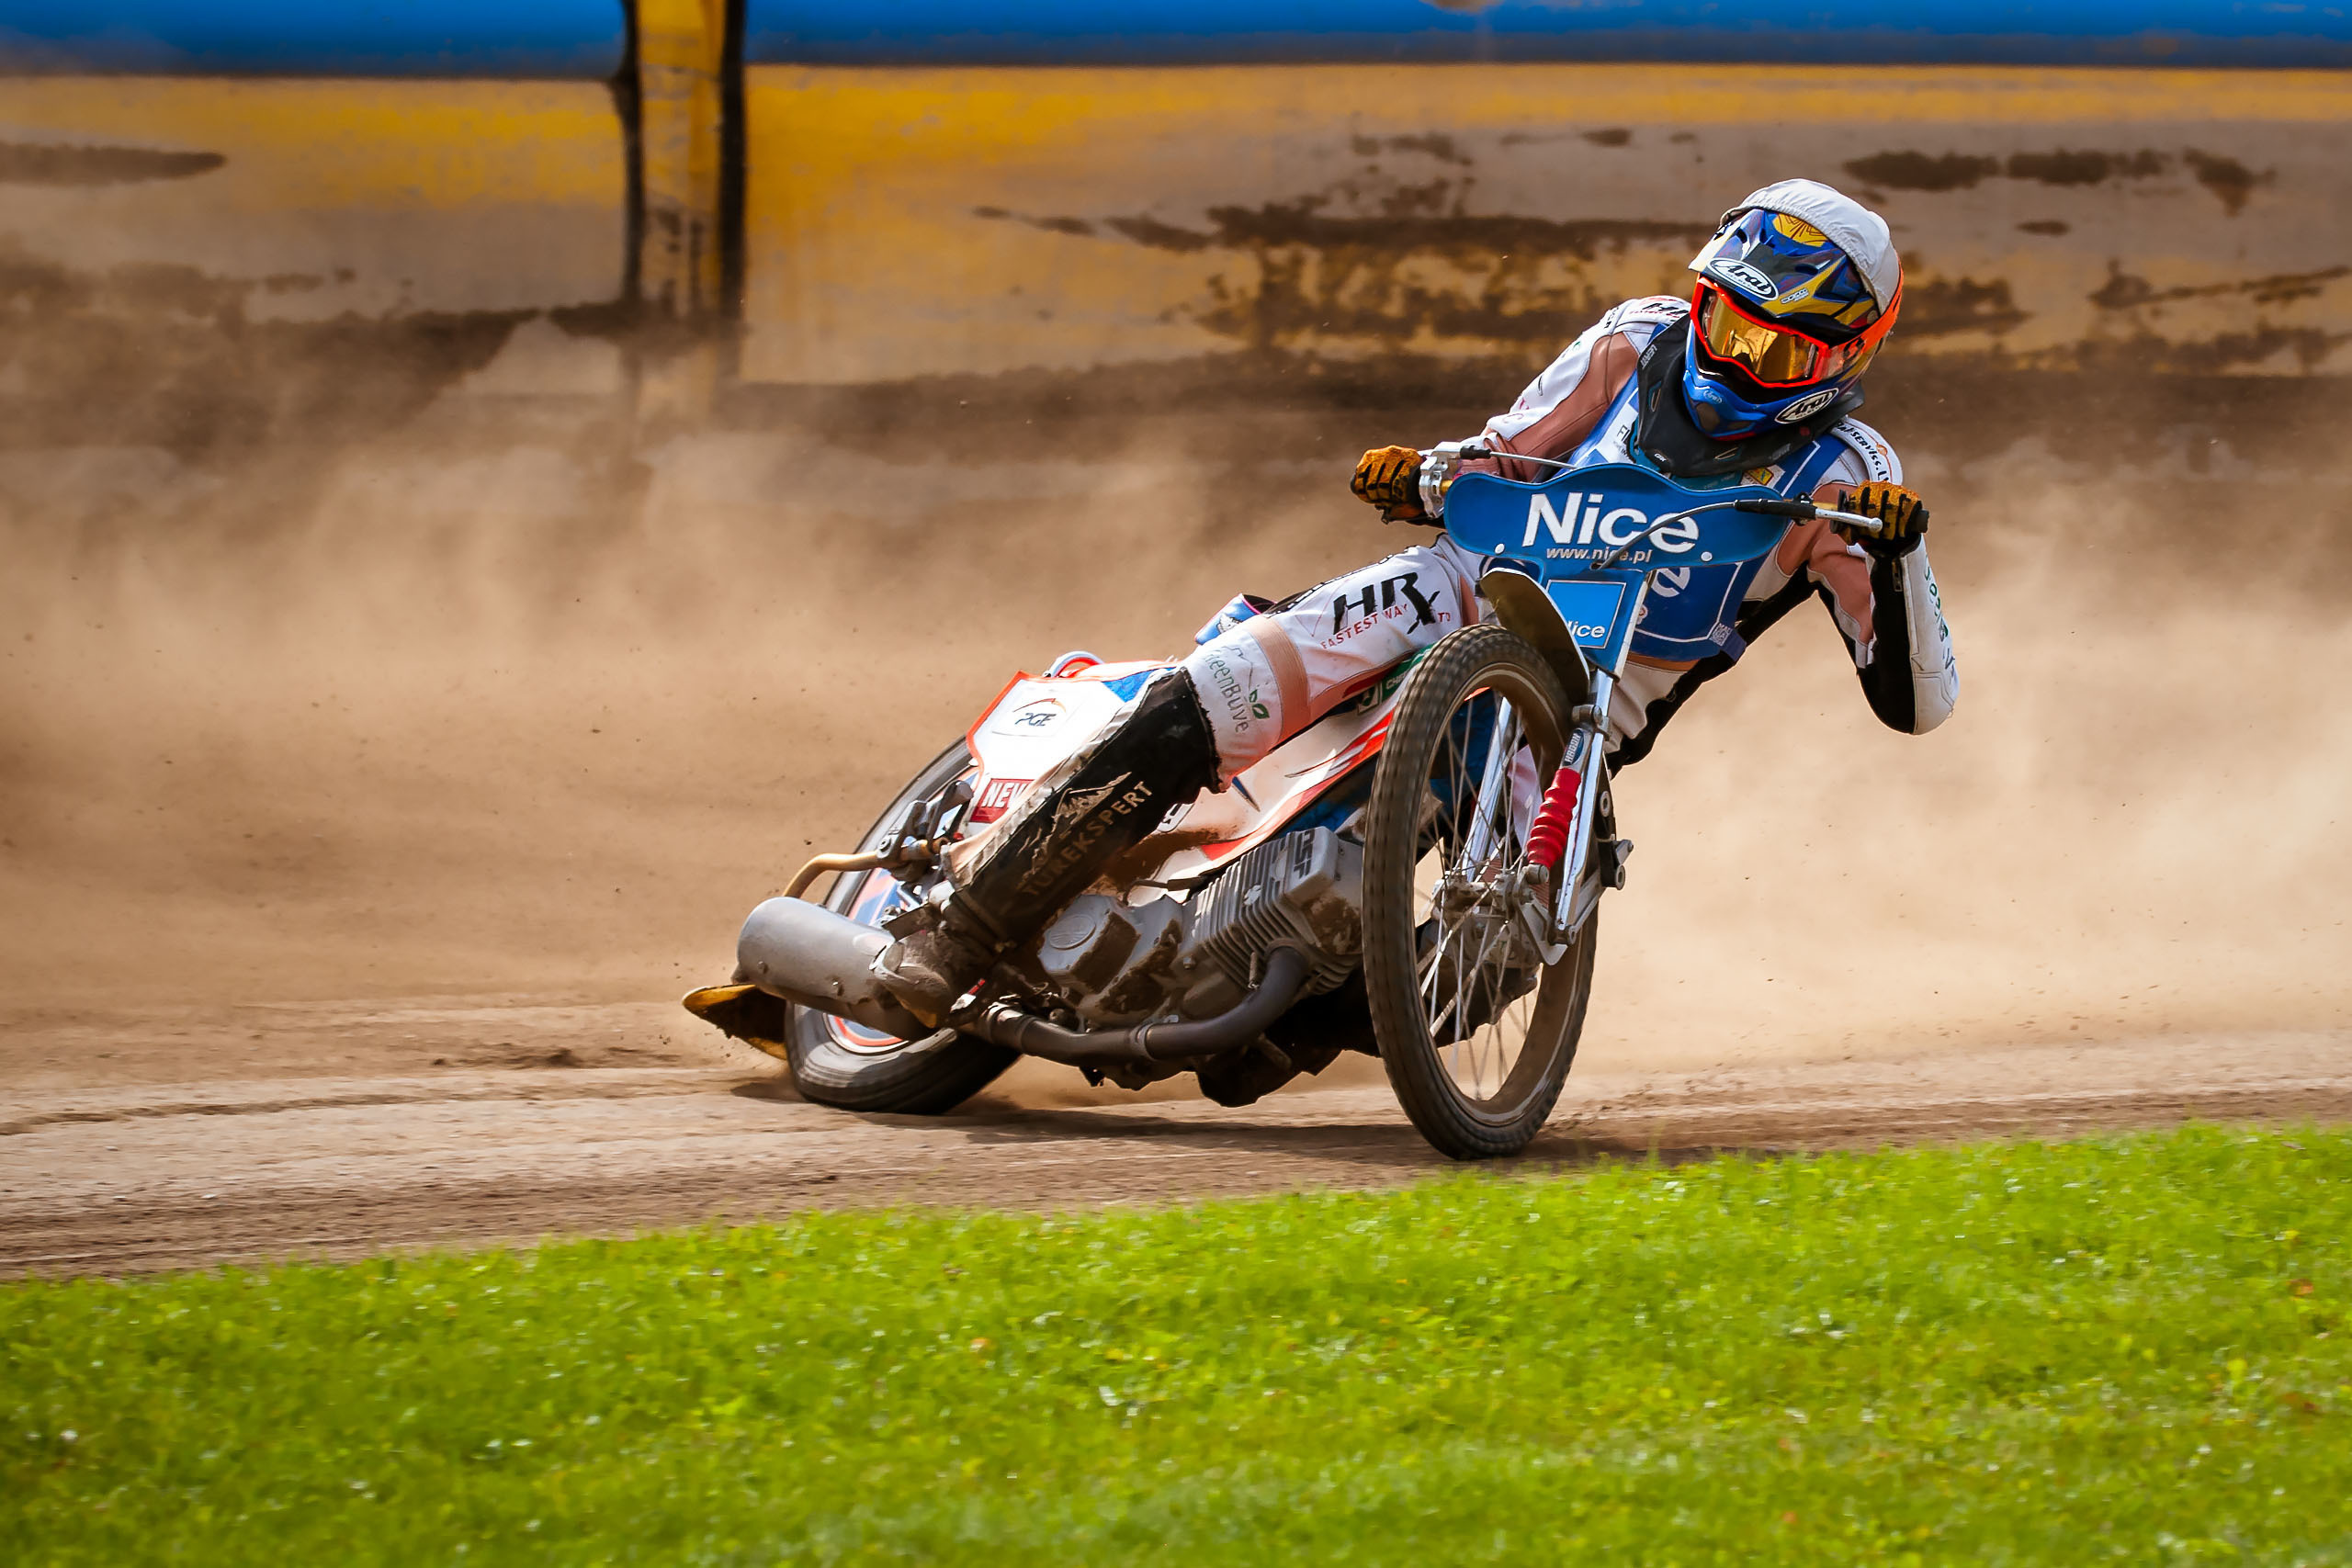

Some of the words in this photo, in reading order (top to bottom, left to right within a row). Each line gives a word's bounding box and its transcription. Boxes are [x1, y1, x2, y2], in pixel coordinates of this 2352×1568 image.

[1713, 264, 1771, 292] Arai
[1782, 392, 1831, 420] Arai
[1521, 491, 1699, 553] Nice
[1320, 613, 1379, 649] FASTEST
[1014, 712, 1057, 727] PGE
